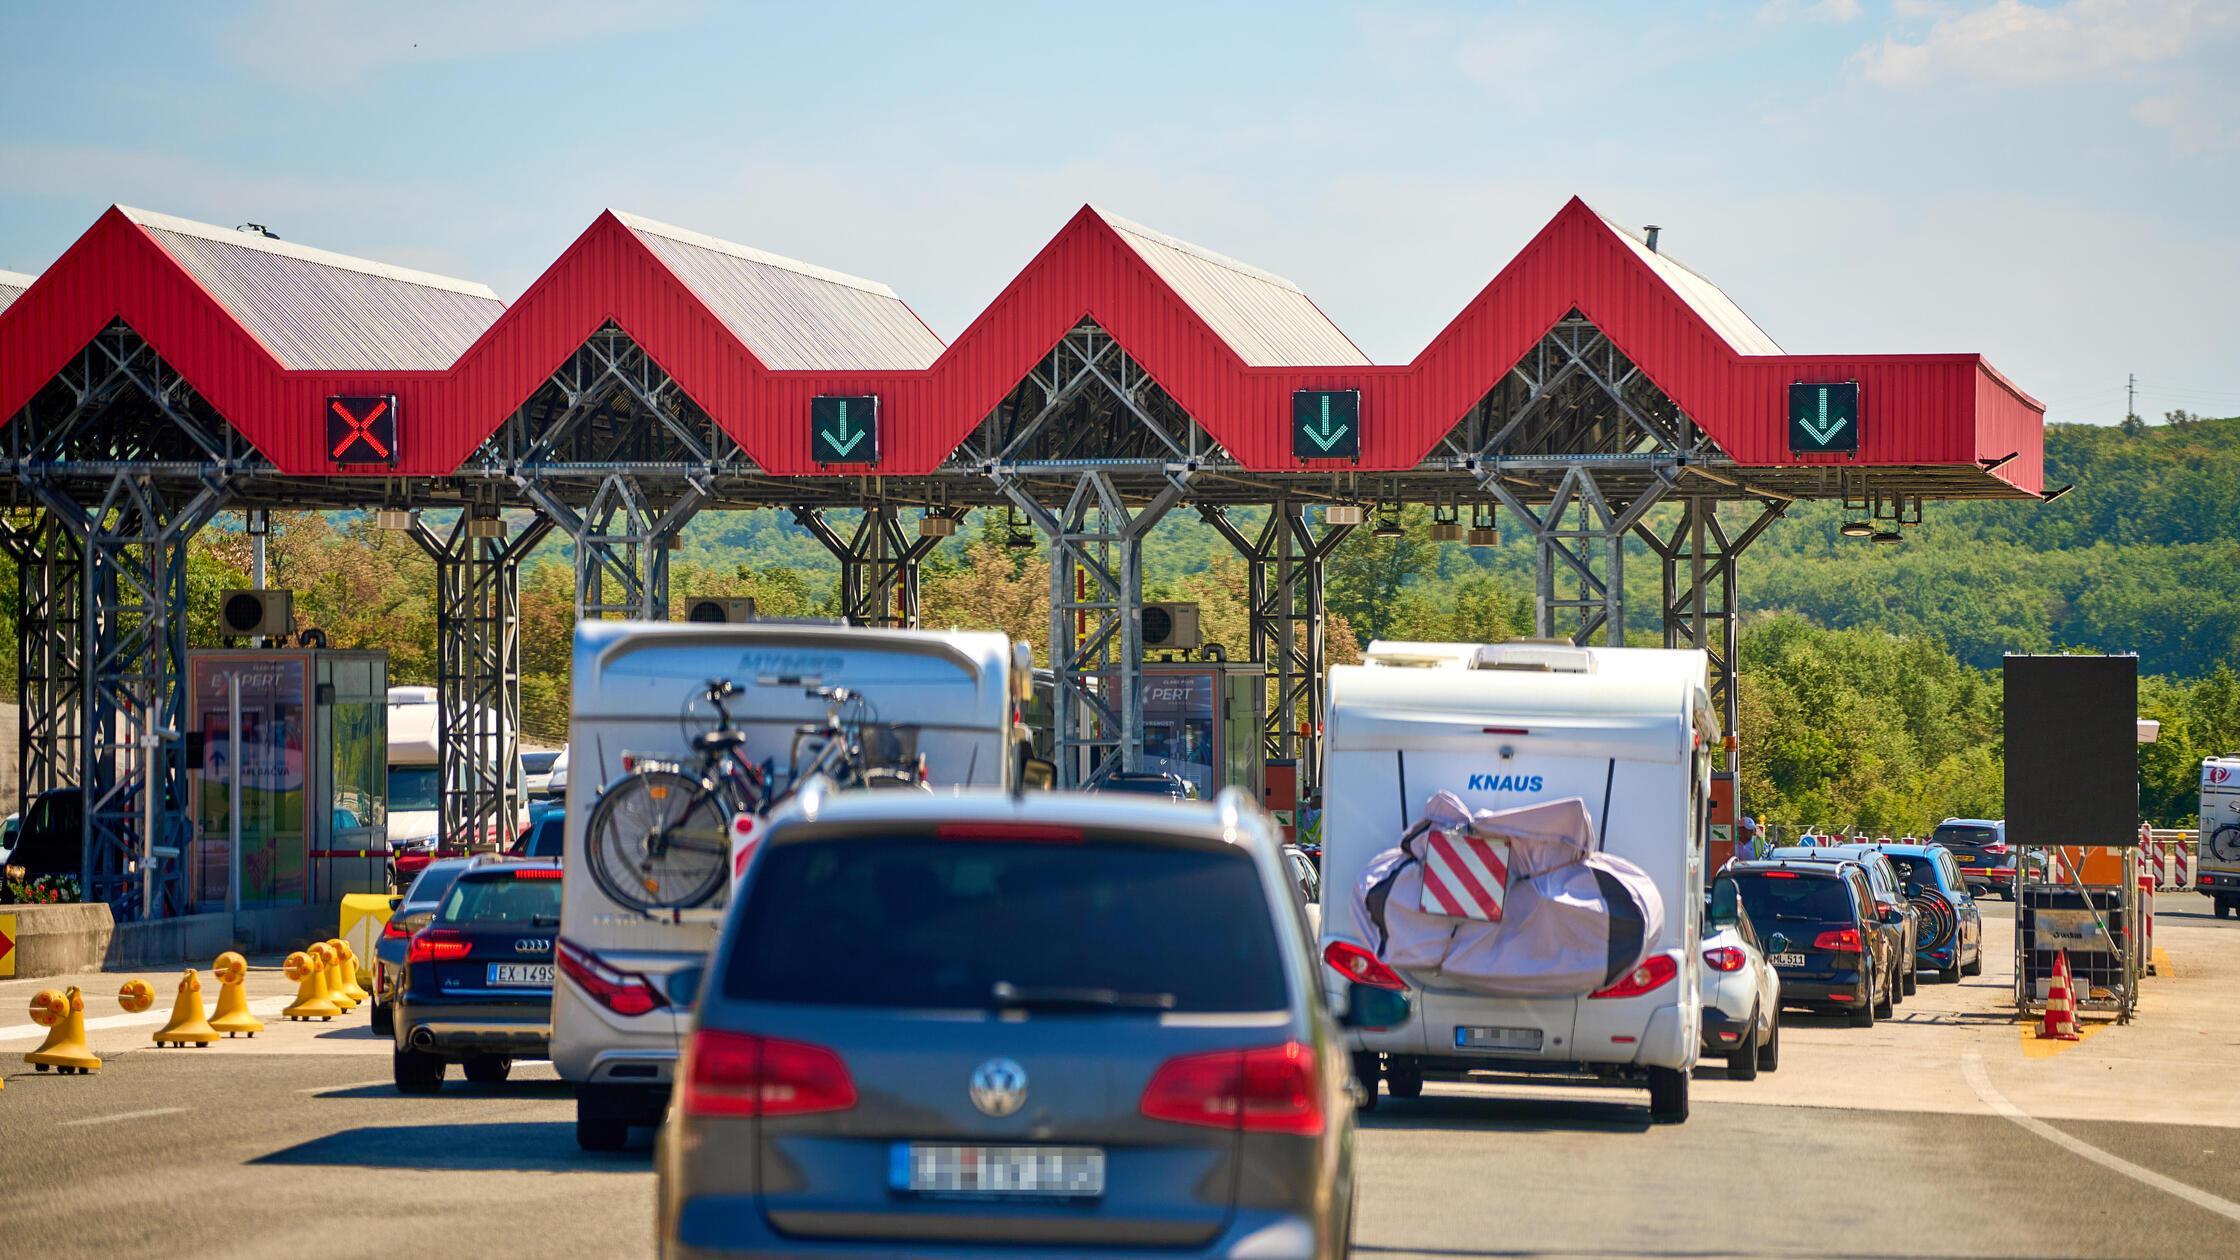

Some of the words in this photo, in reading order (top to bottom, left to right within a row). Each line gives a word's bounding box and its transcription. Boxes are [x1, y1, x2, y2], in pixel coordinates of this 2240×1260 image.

[1468, 774, 1543, 792] KNAUS
[1787, 955, 1804, 965] 511
[498, 966, 516, 982] EX
